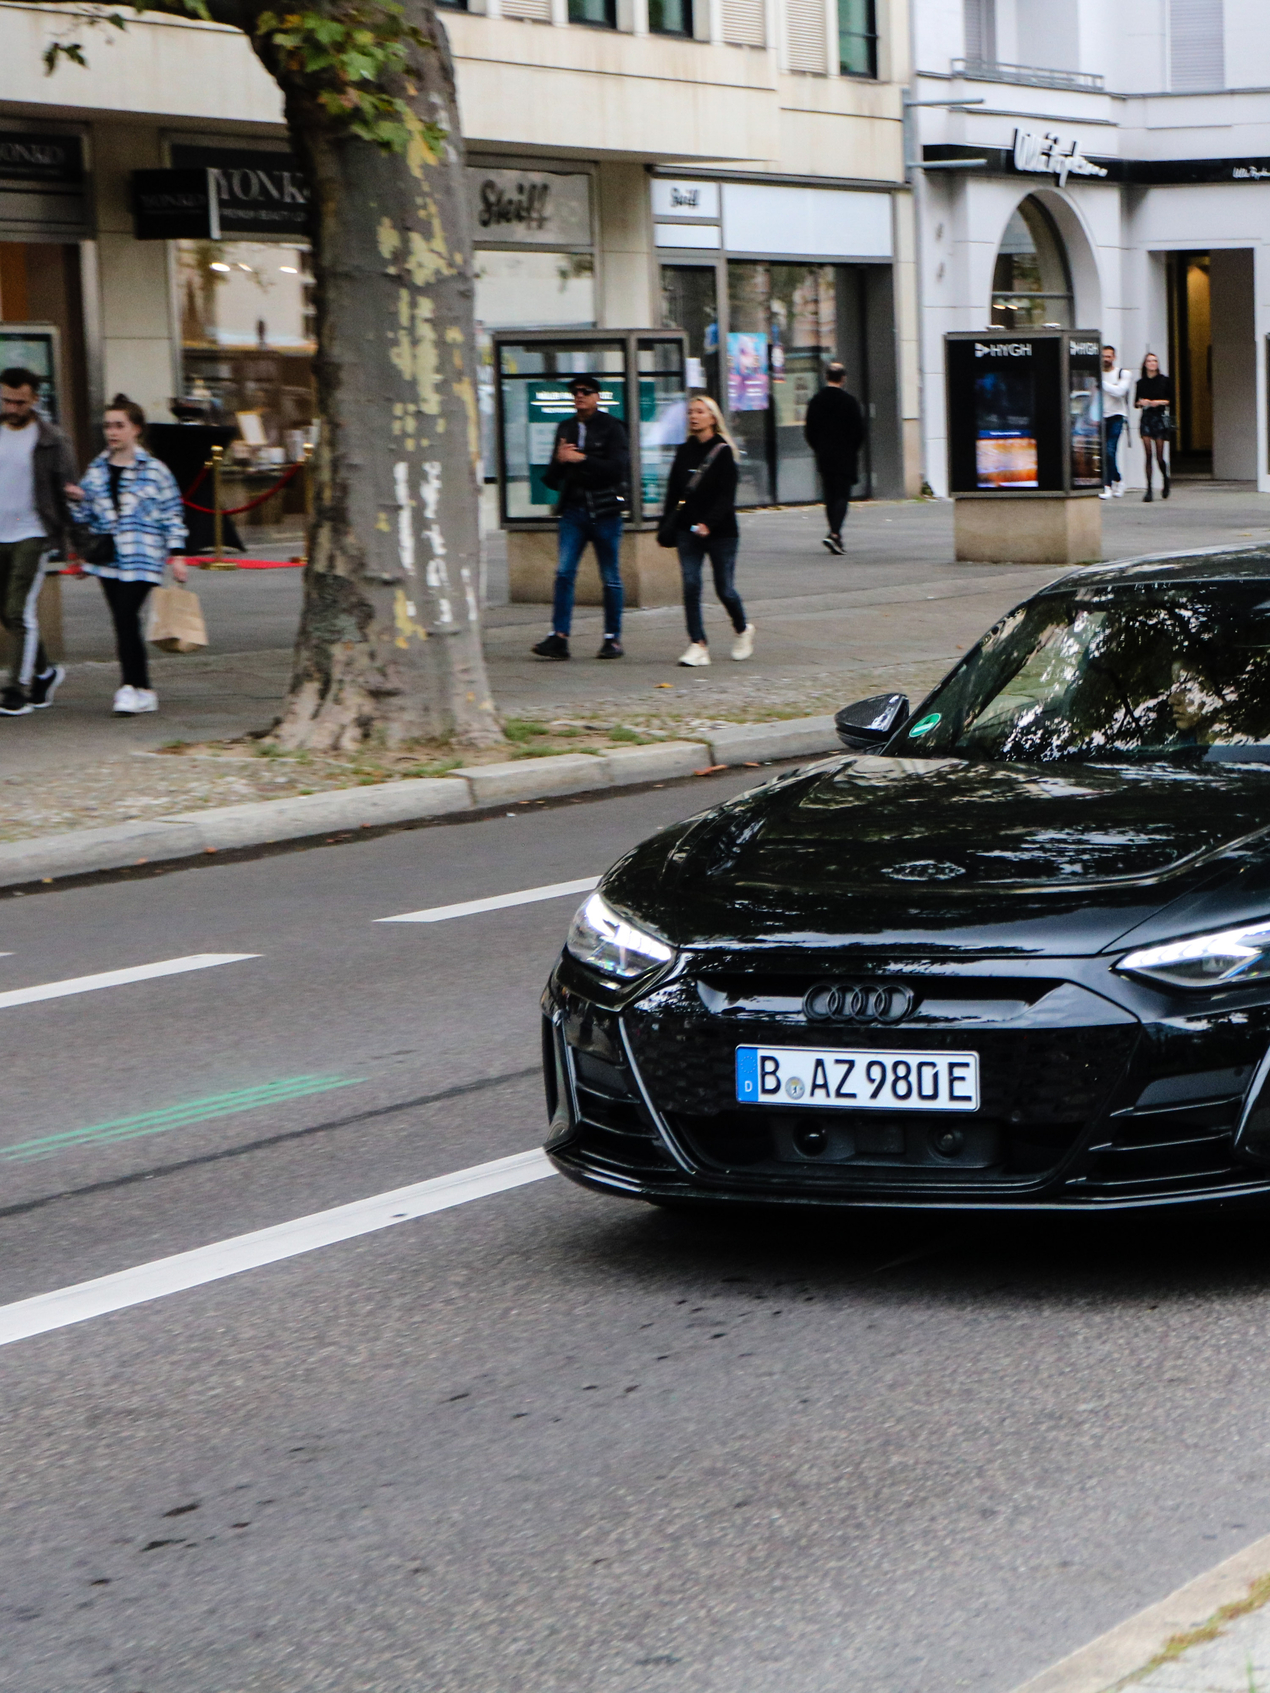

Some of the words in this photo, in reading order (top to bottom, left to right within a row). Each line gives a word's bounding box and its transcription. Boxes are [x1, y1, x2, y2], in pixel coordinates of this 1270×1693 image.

[479, 180, 550, 230] Steiff
[990, 343, 1032, 357] HYGH
[760, 1055, 782, 1095] B
